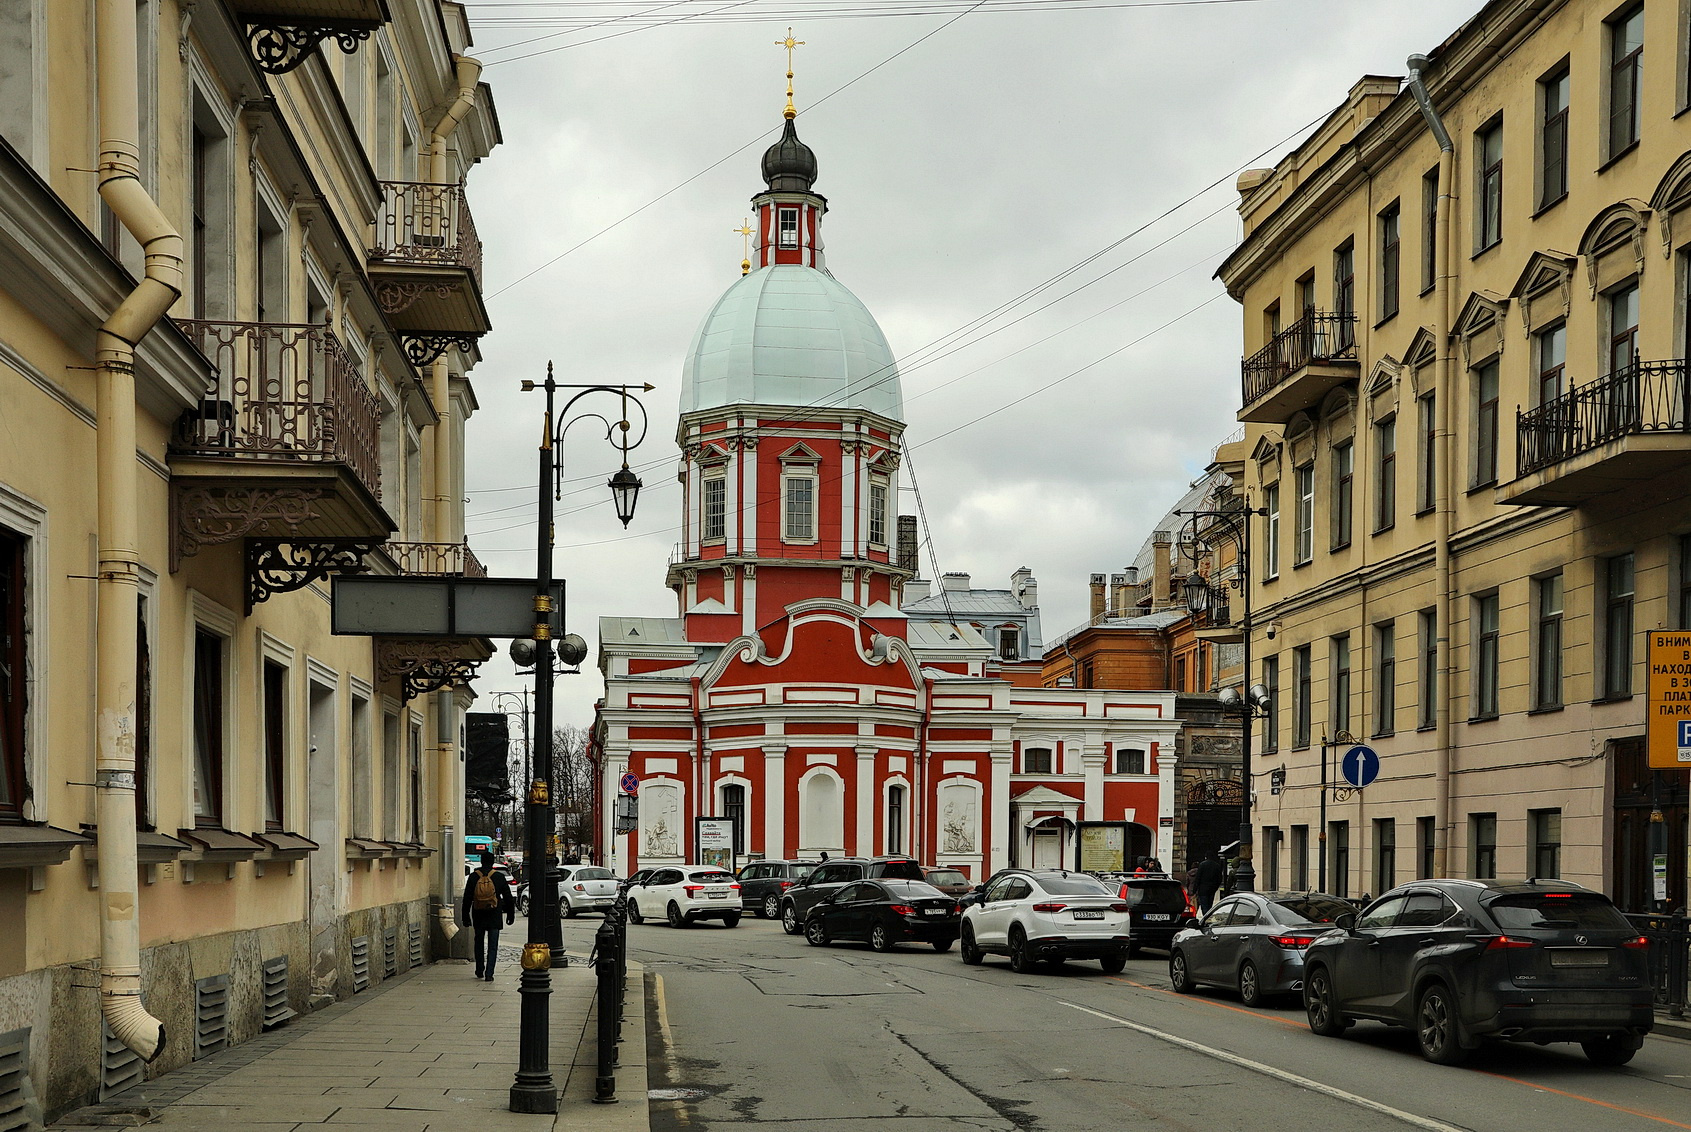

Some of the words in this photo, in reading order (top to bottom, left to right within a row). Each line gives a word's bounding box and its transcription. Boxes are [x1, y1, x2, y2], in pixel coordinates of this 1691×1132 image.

[1657, 637, 1691, 647] ВНИМ
[1653, 664, 1691, 675] НАХОД
[1671, 678, 1678, 688] В
[1682, 678, 1691, 688] З
[1664, 691, 1691, 701] ПЛАТ
[1660, 705, 1691, 715] ПАРК
